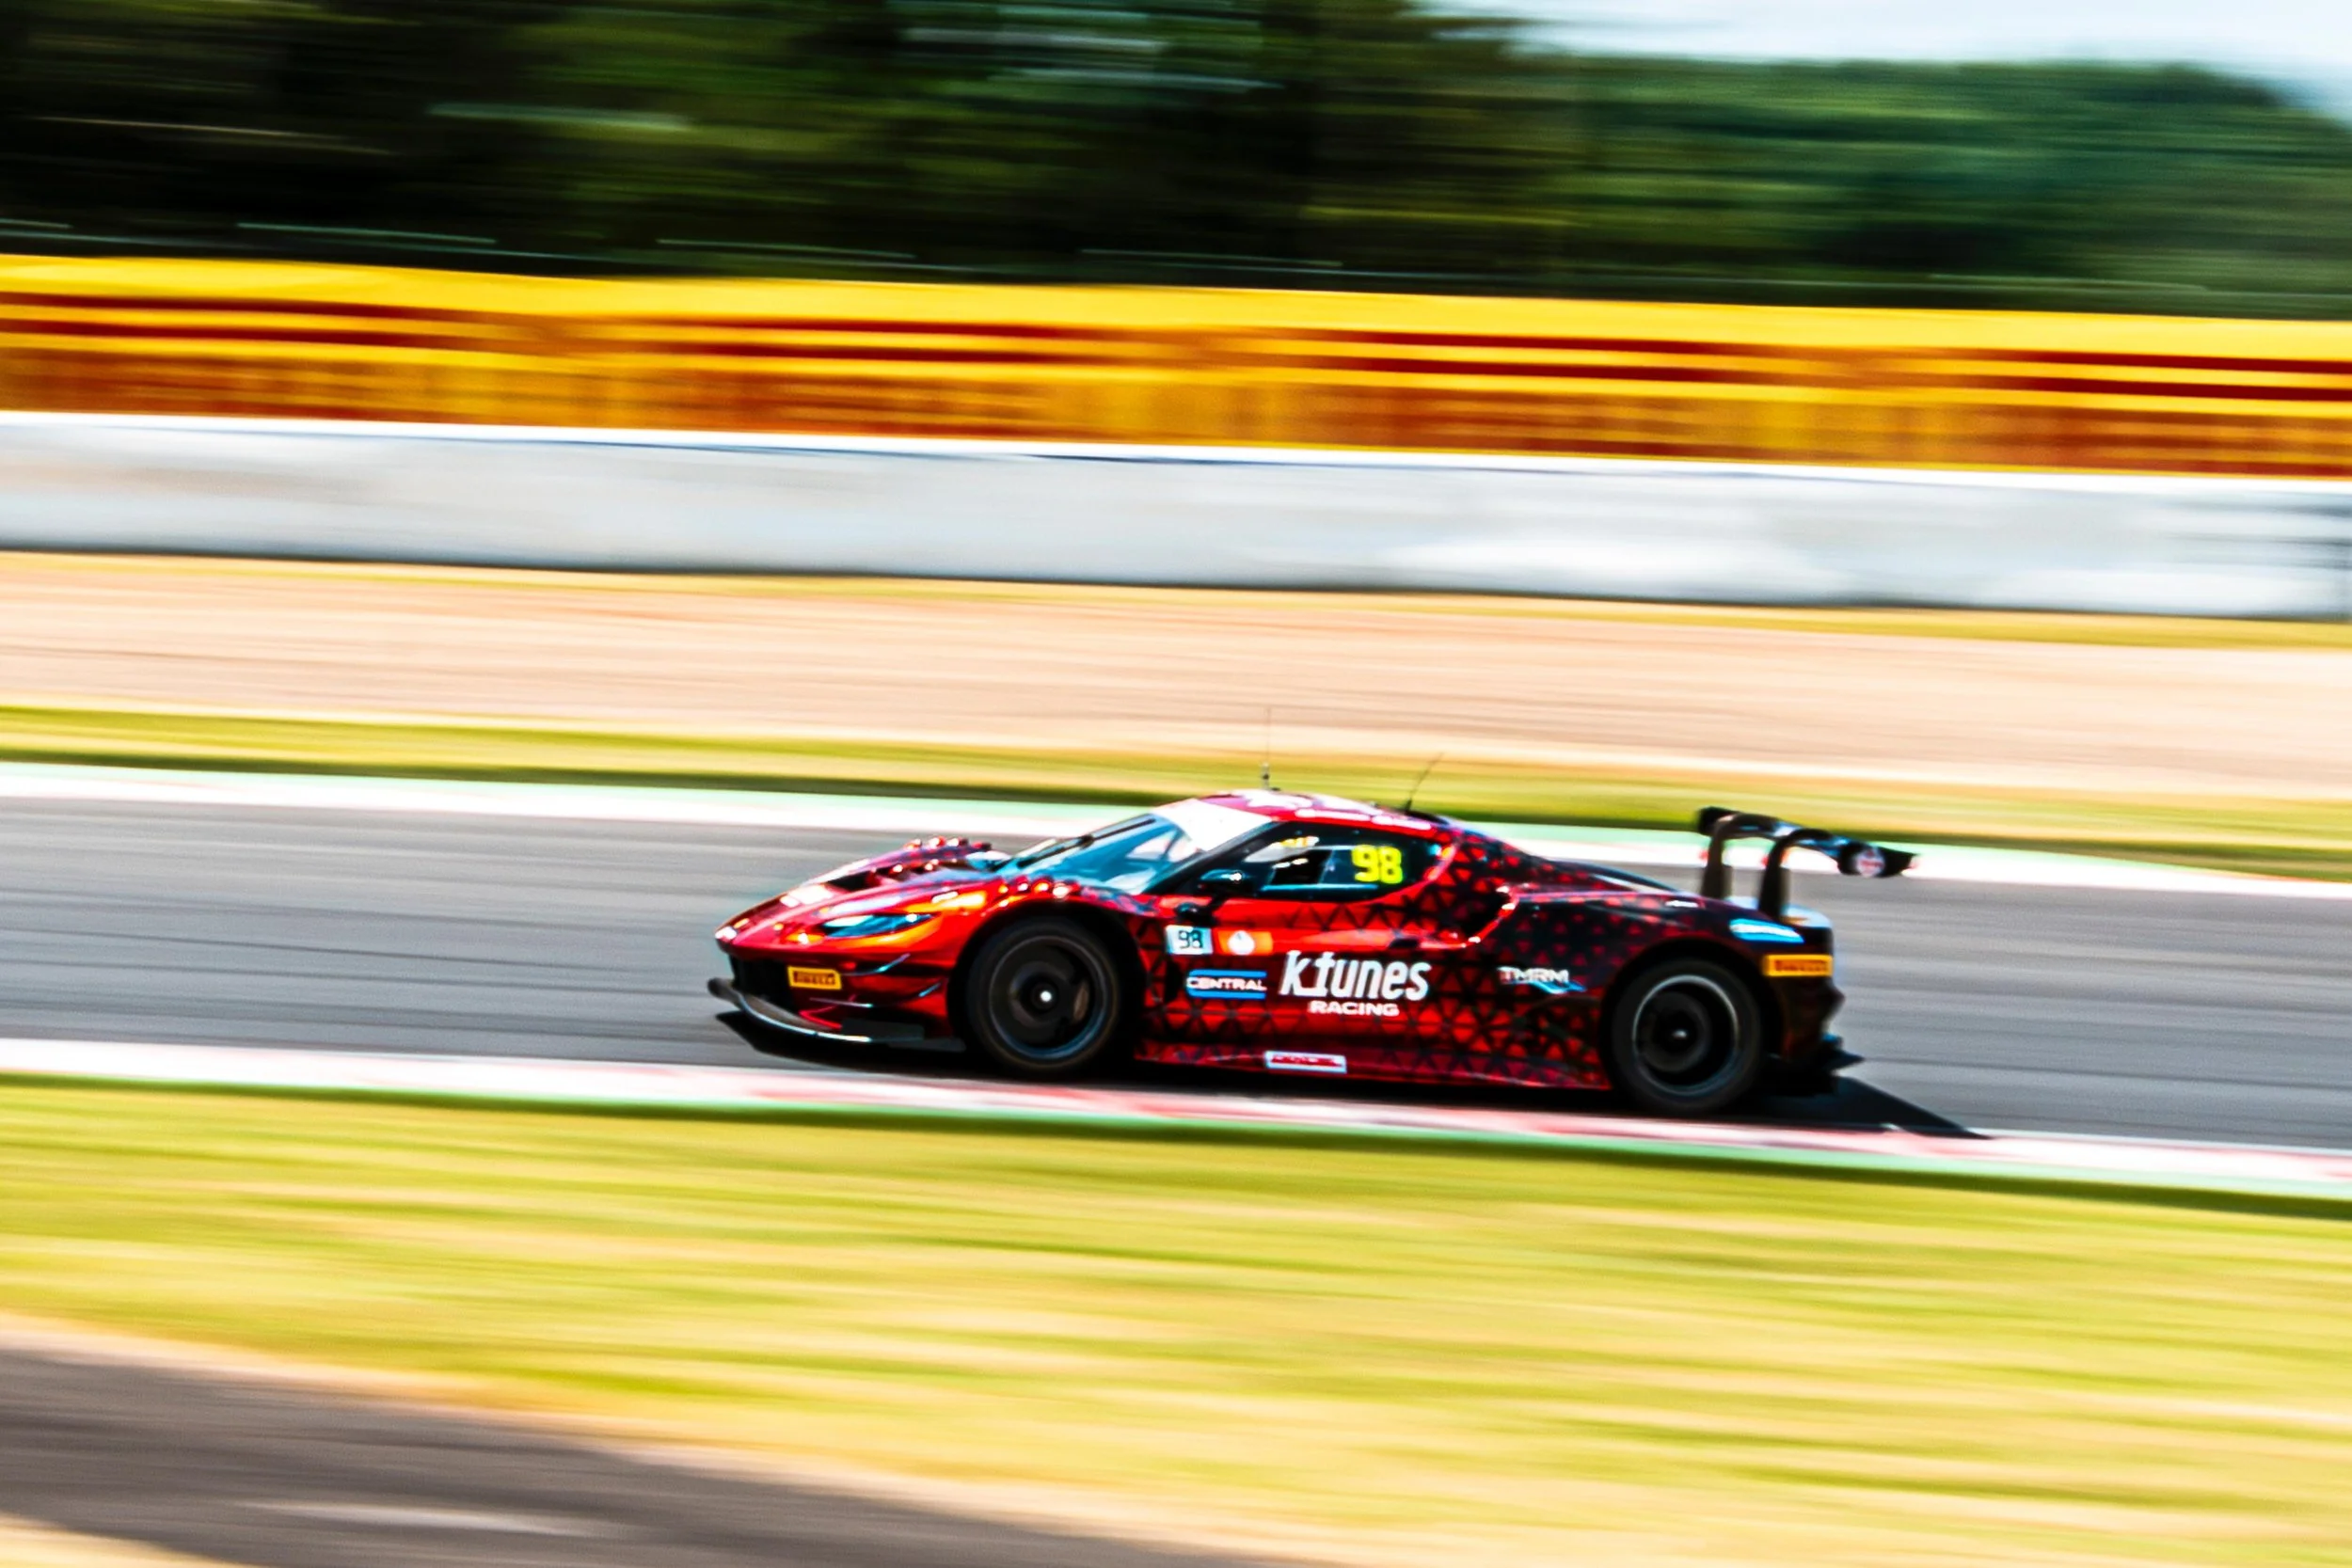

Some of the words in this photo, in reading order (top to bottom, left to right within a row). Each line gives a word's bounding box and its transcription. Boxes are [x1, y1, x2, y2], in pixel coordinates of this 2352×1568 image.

[1352, 845, 1403, 883] 98
[1186, 976, 1267, 991] CENTRAL
[1279, 950, 1432, 1001] ktunes
[1309, 1000, 1399, 1016] RACING
